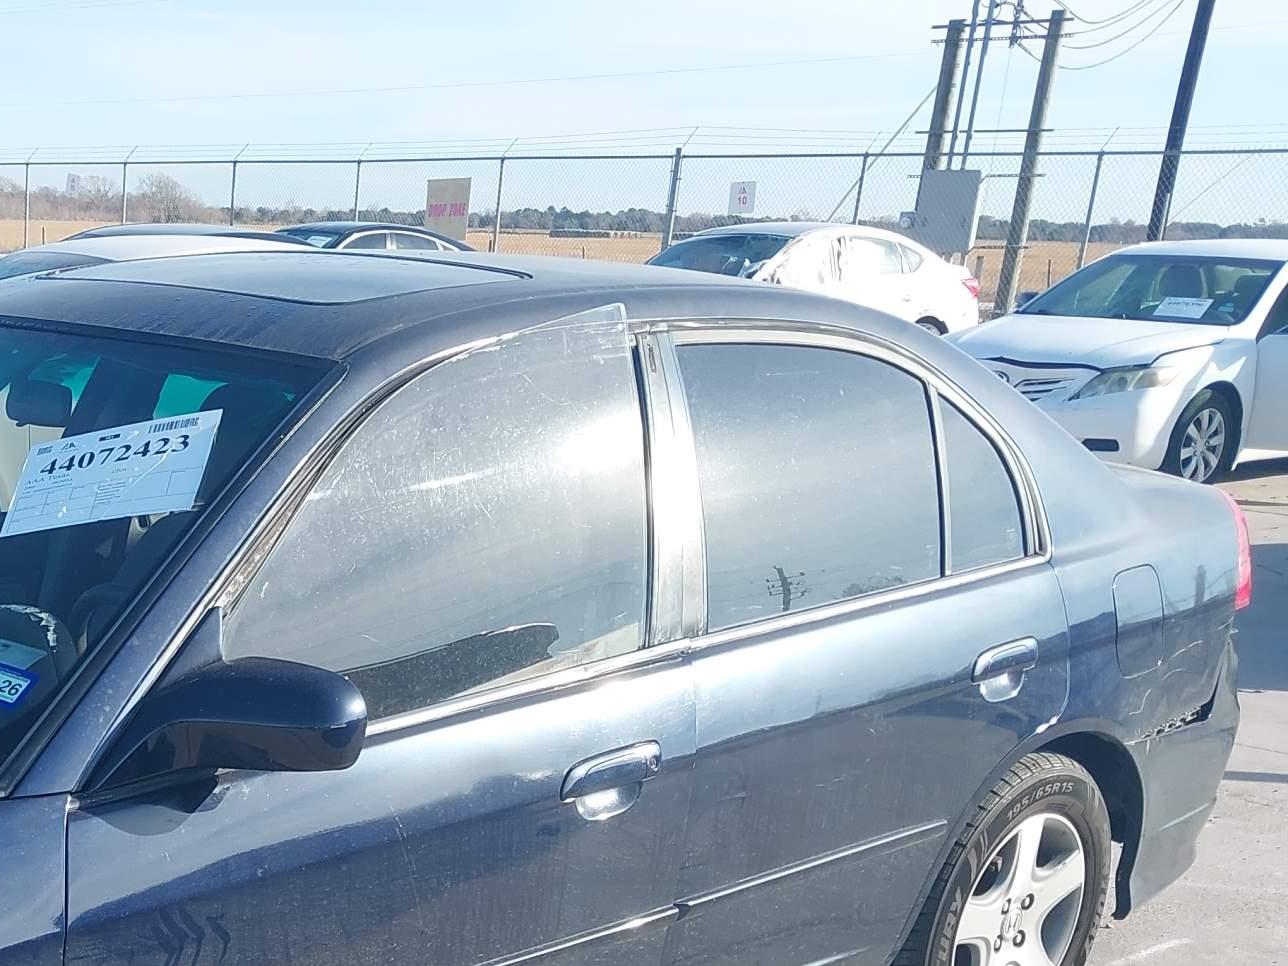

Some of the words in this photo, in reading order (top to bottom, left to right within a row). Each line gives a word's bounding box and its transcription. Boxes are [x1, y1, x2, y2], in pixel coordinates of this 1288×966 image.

[738, 196, 748, 205] 10
[40, 435, 190, 475] 44072423
[1007, 782, 1075, 820] 195/65R15
